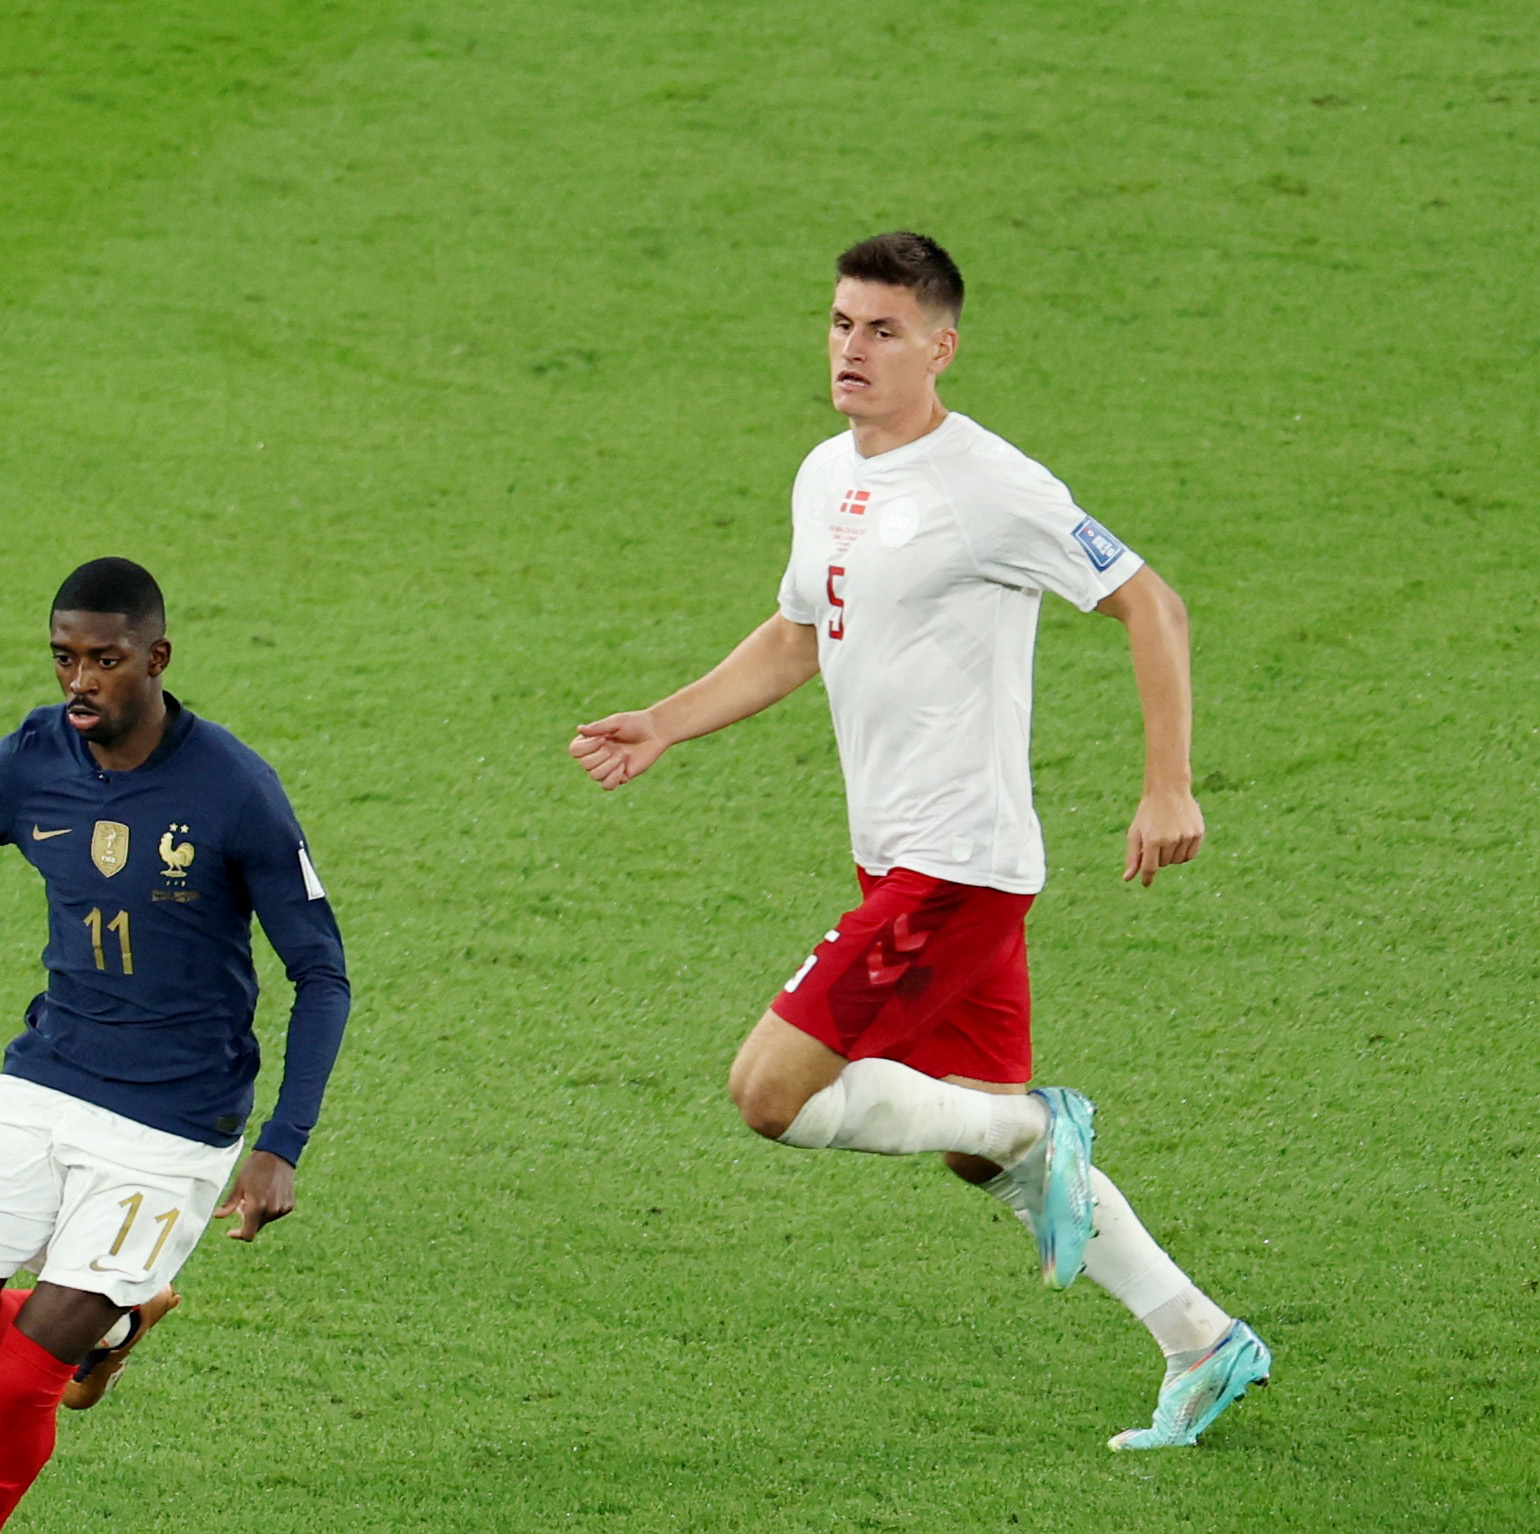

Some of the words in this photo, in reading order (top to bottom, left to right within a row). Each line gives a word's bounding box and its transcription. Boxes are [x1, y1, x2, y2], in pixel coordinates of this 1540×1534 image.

[827, 565, 845, 641] 5
[83, 907, 134, 975] 11
[108, 1191, 181, 1272] 11
